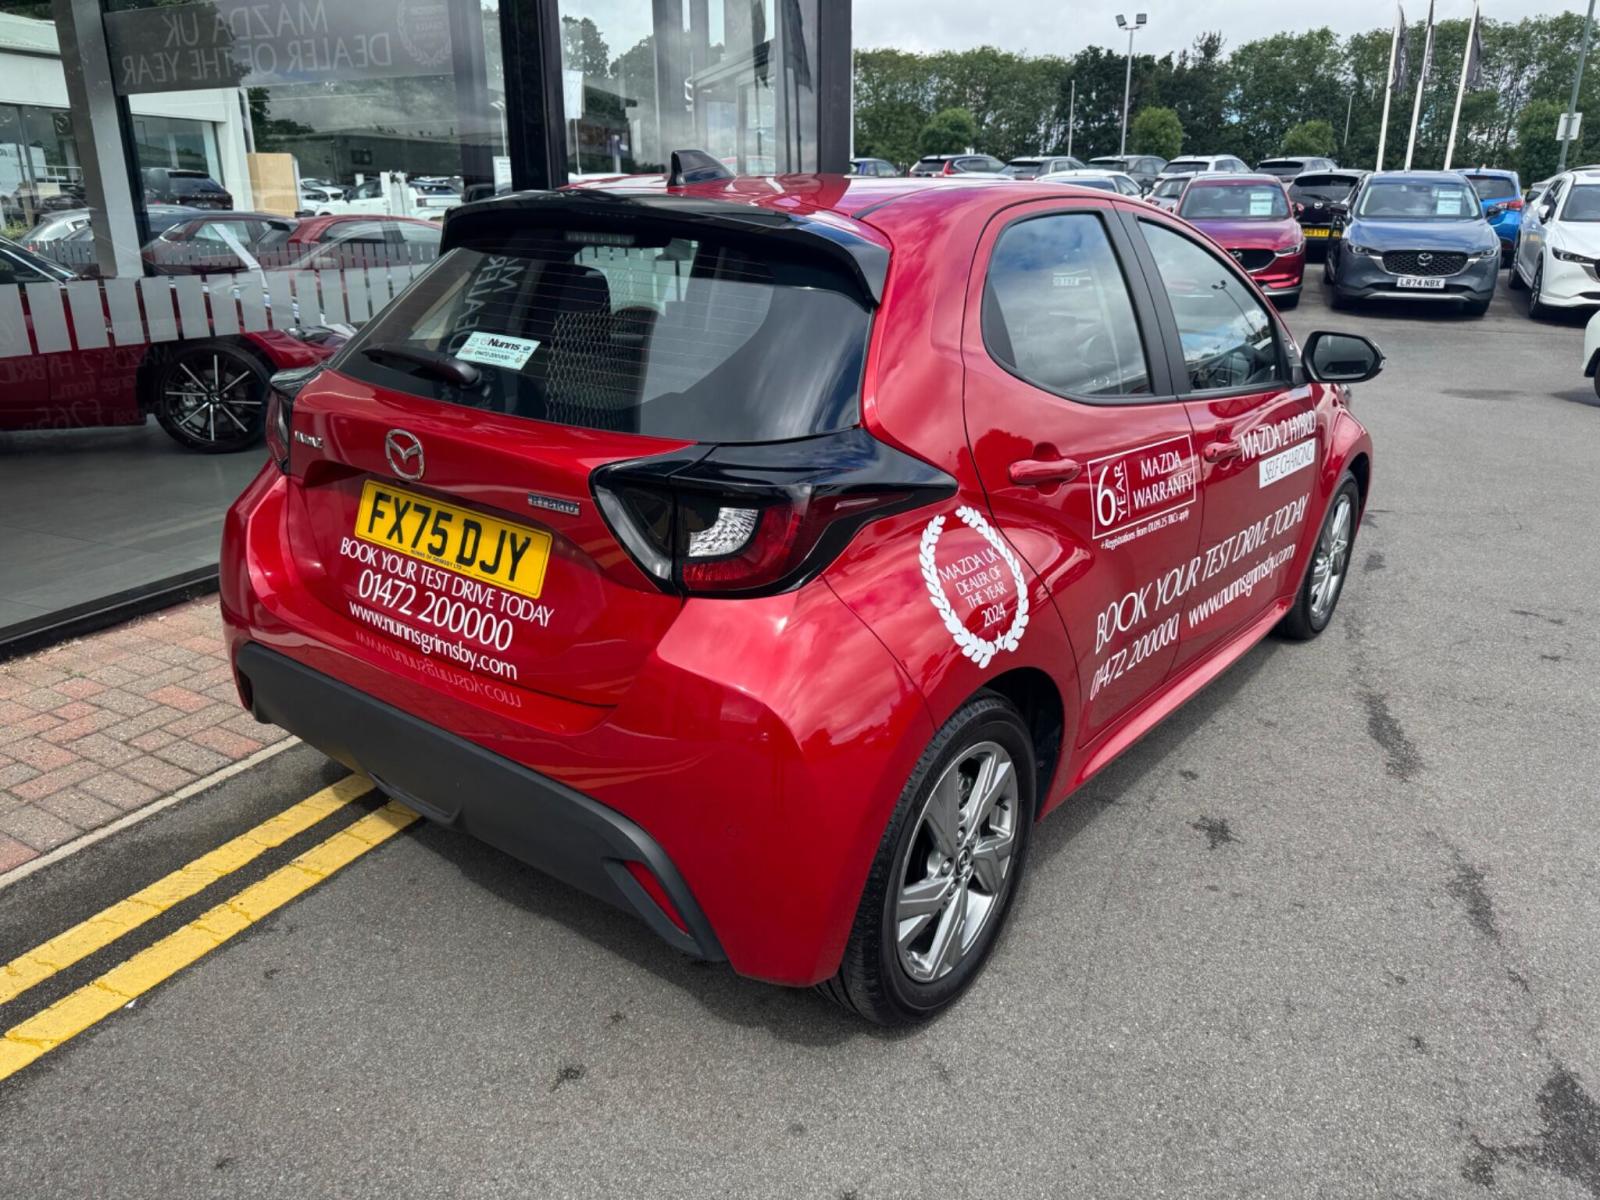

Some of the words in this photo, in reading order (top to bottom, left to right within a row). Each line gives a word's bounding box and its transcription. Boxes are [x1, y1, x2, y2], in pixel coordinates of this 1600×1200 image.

[1400, 278, 1423, 288] LR74
[487, 338, 522, 351] Nunns
[1240, 423, 1282, 462] MAZDA
[1281, 420, 1289, 445] 2
[1288, 410, 1316, 442] HYBRID
[1114, 462, 1127, 521] YEAR
[1133, 471, 1194, 510] WARRANTY
[1141, 450, 1182, 480] MAZDA
[1097, 465, 1116, 527] 6
[368, 491, 453, 557] FX75
[456, 518, 532, 582] DJY
[340, 537, 379, 567] BOOK
[382, 552, 417, 582] YOUR
[420, 564, 451, 592] TEST
[452, 577, 496, 609] DRIVE
[500, 592, 555, 627] TODAY
[938, 554, 986, 583] MAZDA
[981, 547, 1001, 564] UK
[955, 571, 992, 596] DEALER
[988, 565, 1002, 580] OF
[1096, 582, 1153, 655] BOOK
[1155, 556, 1200, 612] YOUR
[1201, 535, 1236, 582] TEST
[1233, 515, 1273, 562] DRIVE
[1271, 492, 1310, 539] TODAY
[1189, 543, 1297, 629] www.nunnsgrimsby.com
[359, 569, 417, 616] 01472
[418, 591, 513, 651] 200000
[965, 592, 985, 609] THE
[982, 581, 1008, 601] YEAR
[981, 602, 1007, 627] 2024
[349, 601, 518, 681] www.nunnsgrimsby.com
[1090, 648, 1127, 701] 01472
[1126, 613, 1180, 671] 200000
